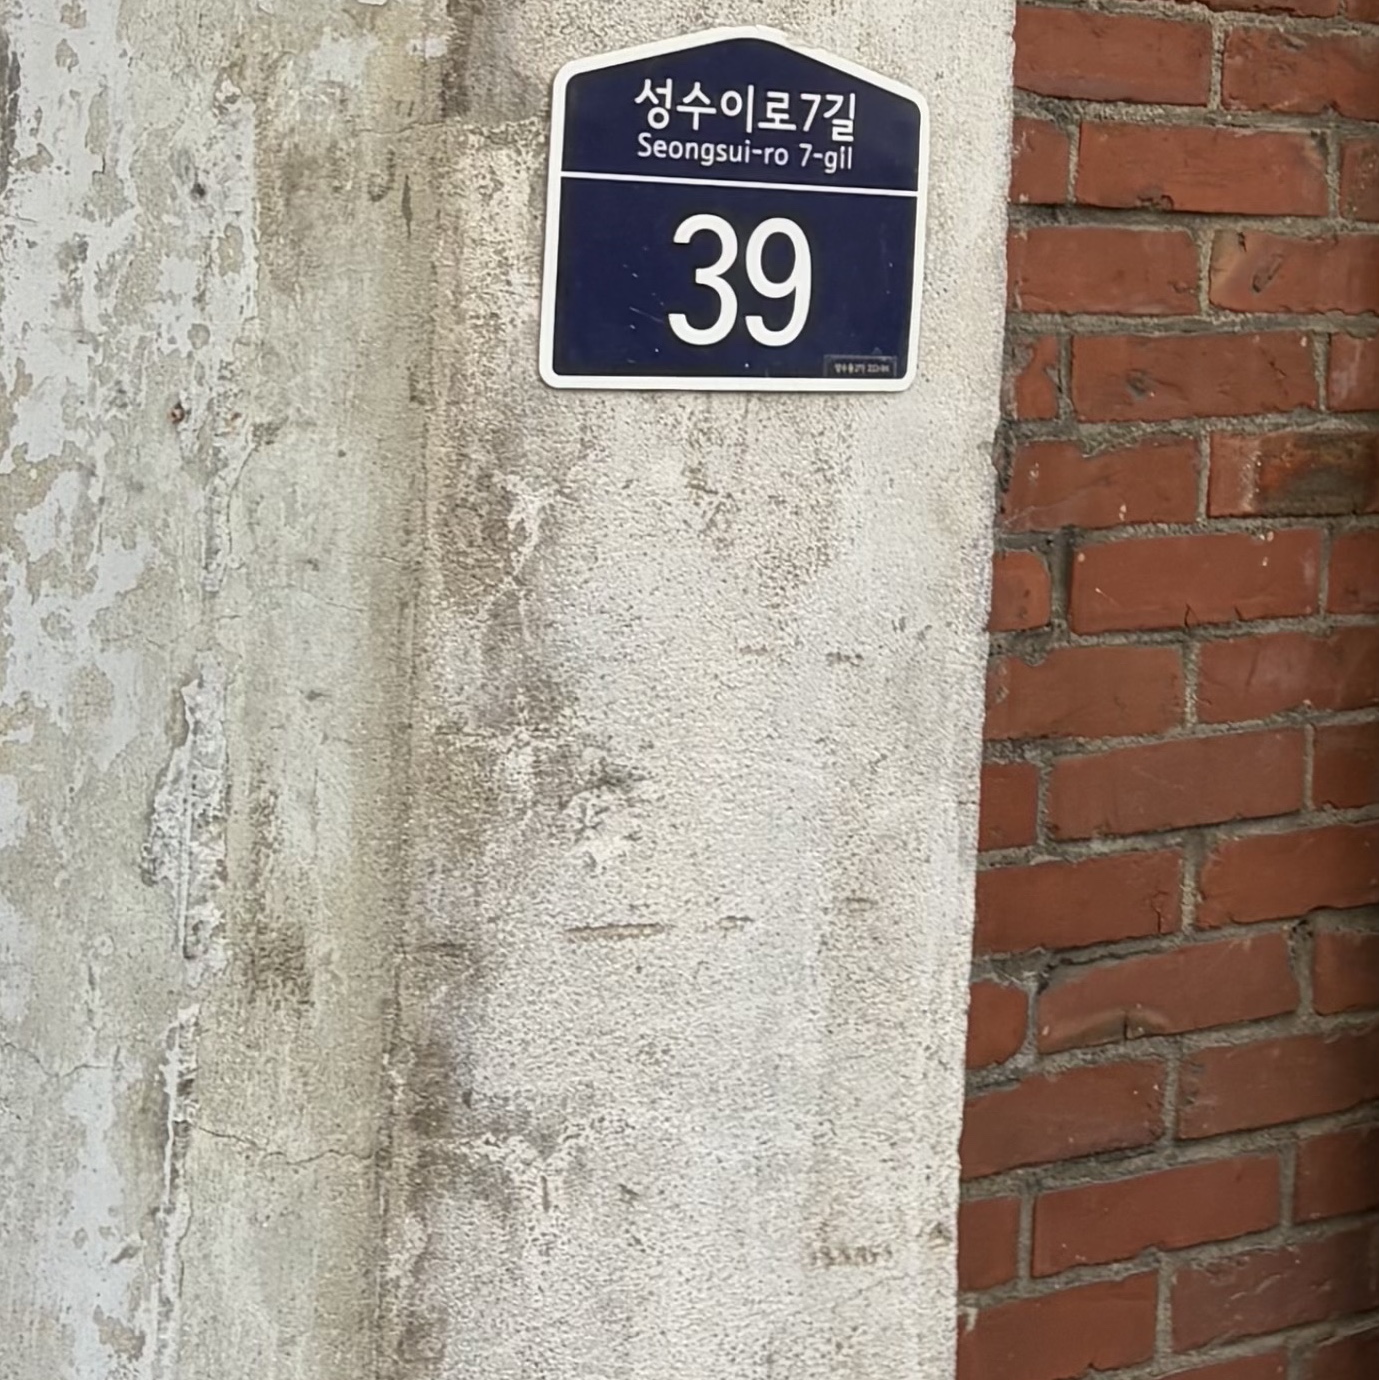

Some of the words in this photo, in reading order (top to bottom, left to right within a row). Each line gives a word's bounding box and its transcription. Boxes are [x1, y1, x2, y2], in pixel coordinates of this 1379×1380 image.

[634, 78, 856, 142] 성수이로7길
[637, 132, 788, 168] Seongsui-ro
[799, 143, 853, 174] 7-gil
[667, 213, 813, 347] 39
